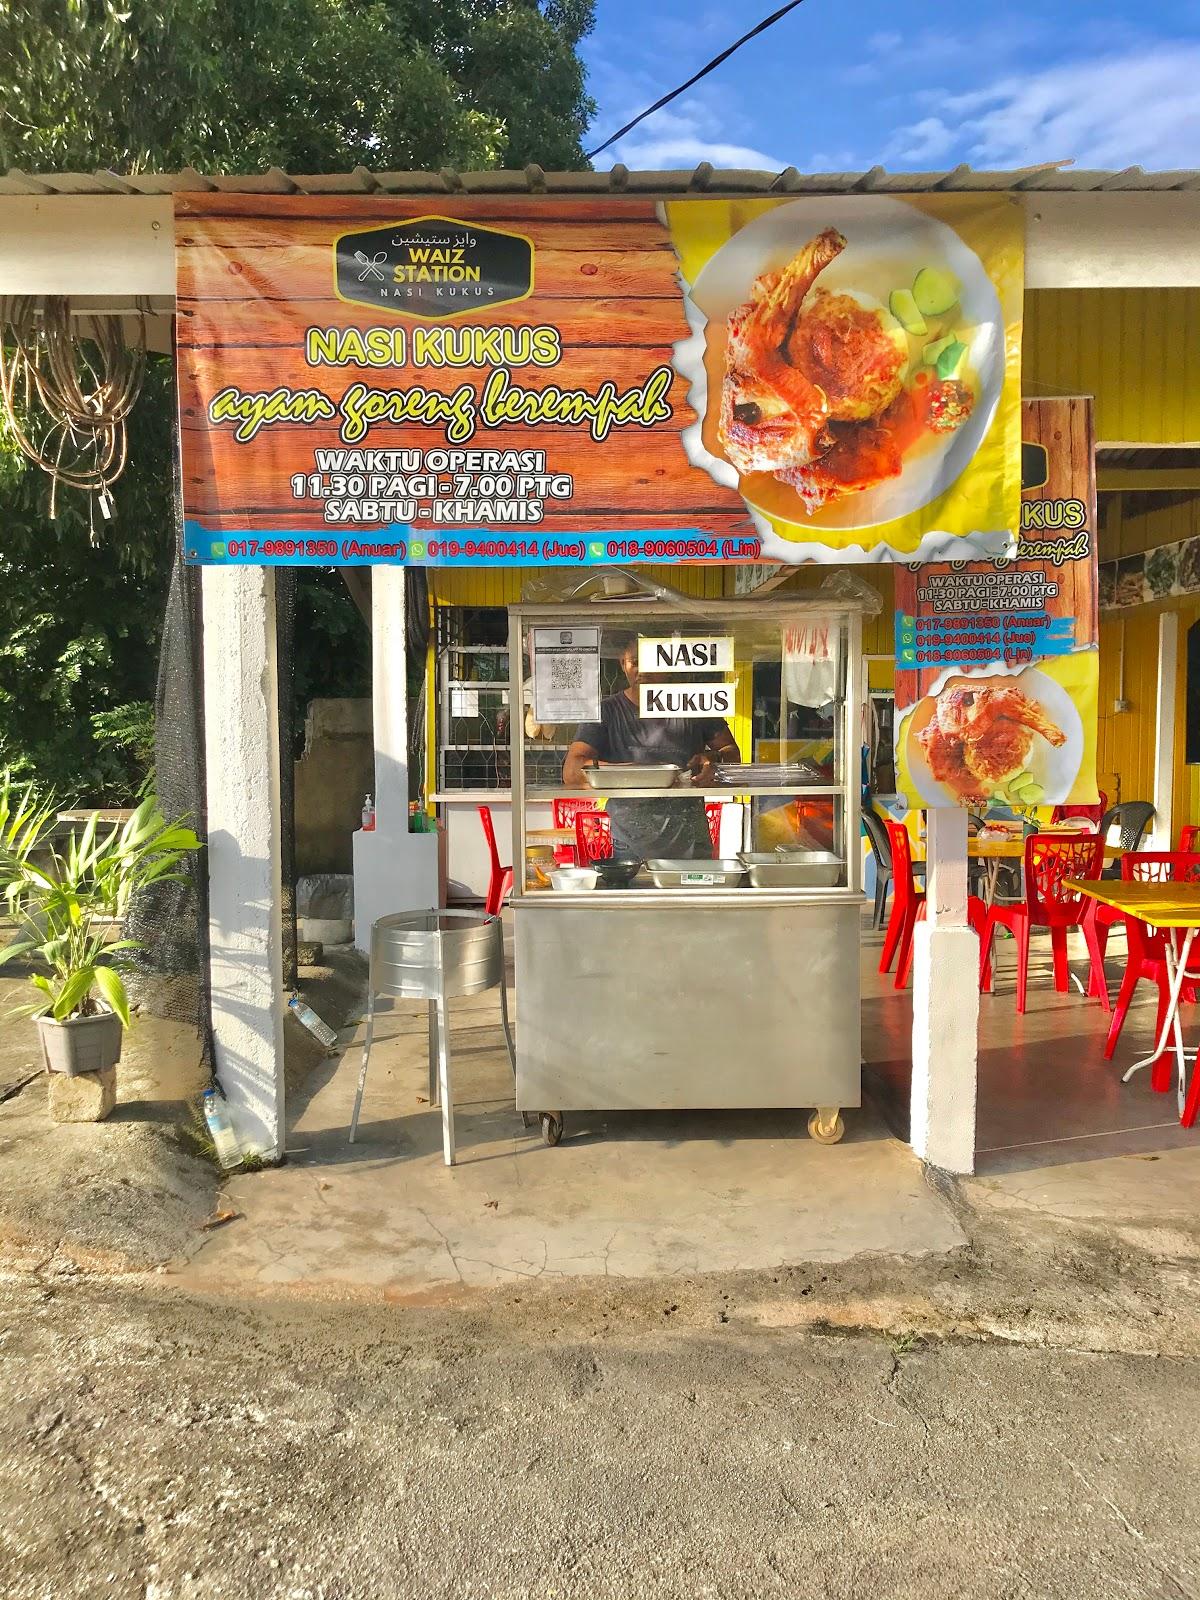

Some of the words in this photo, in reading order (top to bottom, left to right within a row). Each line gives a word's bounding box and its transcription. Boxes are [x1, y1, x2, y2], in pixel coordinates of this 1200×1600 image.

[453, 232, 477, 248] وايز
[409, 248, 466, 264] WAIZ
[393, 265, 481, 282] STATION
[380, 288, 422, 297] NASI
[436, 287, 495, 296] KUKUS
[308, 329, 405, 364] NASI
[415, 328, 561, 365] KUKUS
[211, 388, 336, 440] ayam
[341, 384, 475, 441] goreng
[483, 369, 671, 440] berempah
[316, 450, 423, 472] WAKTU
[425, 450, 545, 472] OPERASI
[292, 475, 365, 497] 11.30
[371, 475, 436, 497] PAGI
[455, 475, 515, 497] 7.00
[518, 475, 572, 497] PTG
[325, 500, 418, 522] SABTU
[434, 500, 543, 522] KHAMIS
[1022, 501, 1085, 528] KUS
[228, 540, 337, 557] 017-9891350
[342, 540, 406, 560] (Anuar)
[428, 540, 538, 557] 019-9400414
[543, 540, 585, 560] (Jue)
[607, 540, 717, 557] 018-9060504
[722, 539, 761, 560] (Lin)
[1017, 531, 1089, 565] erempah
[929, 575, 985, 588] WAKTU
[985, 572, 1045, 586] OPERASI
[918, 588, 955, 600] 11.30
[957, 587, 990, 599] PAGI
[999, 586, 1029, 598] 7.00
[1030, 584, 1057, 596] PTG
[934, 599, 981, 611] SABTU
[989, 597, 1043, 609] KHAMIS
[1003, 615, 1051, 629] (Anuar)
[916, 633, 1000, 646] 019-9400414
[656, 643, 717, 667] NASI
[646, 689, 729, 712] KUKUS
